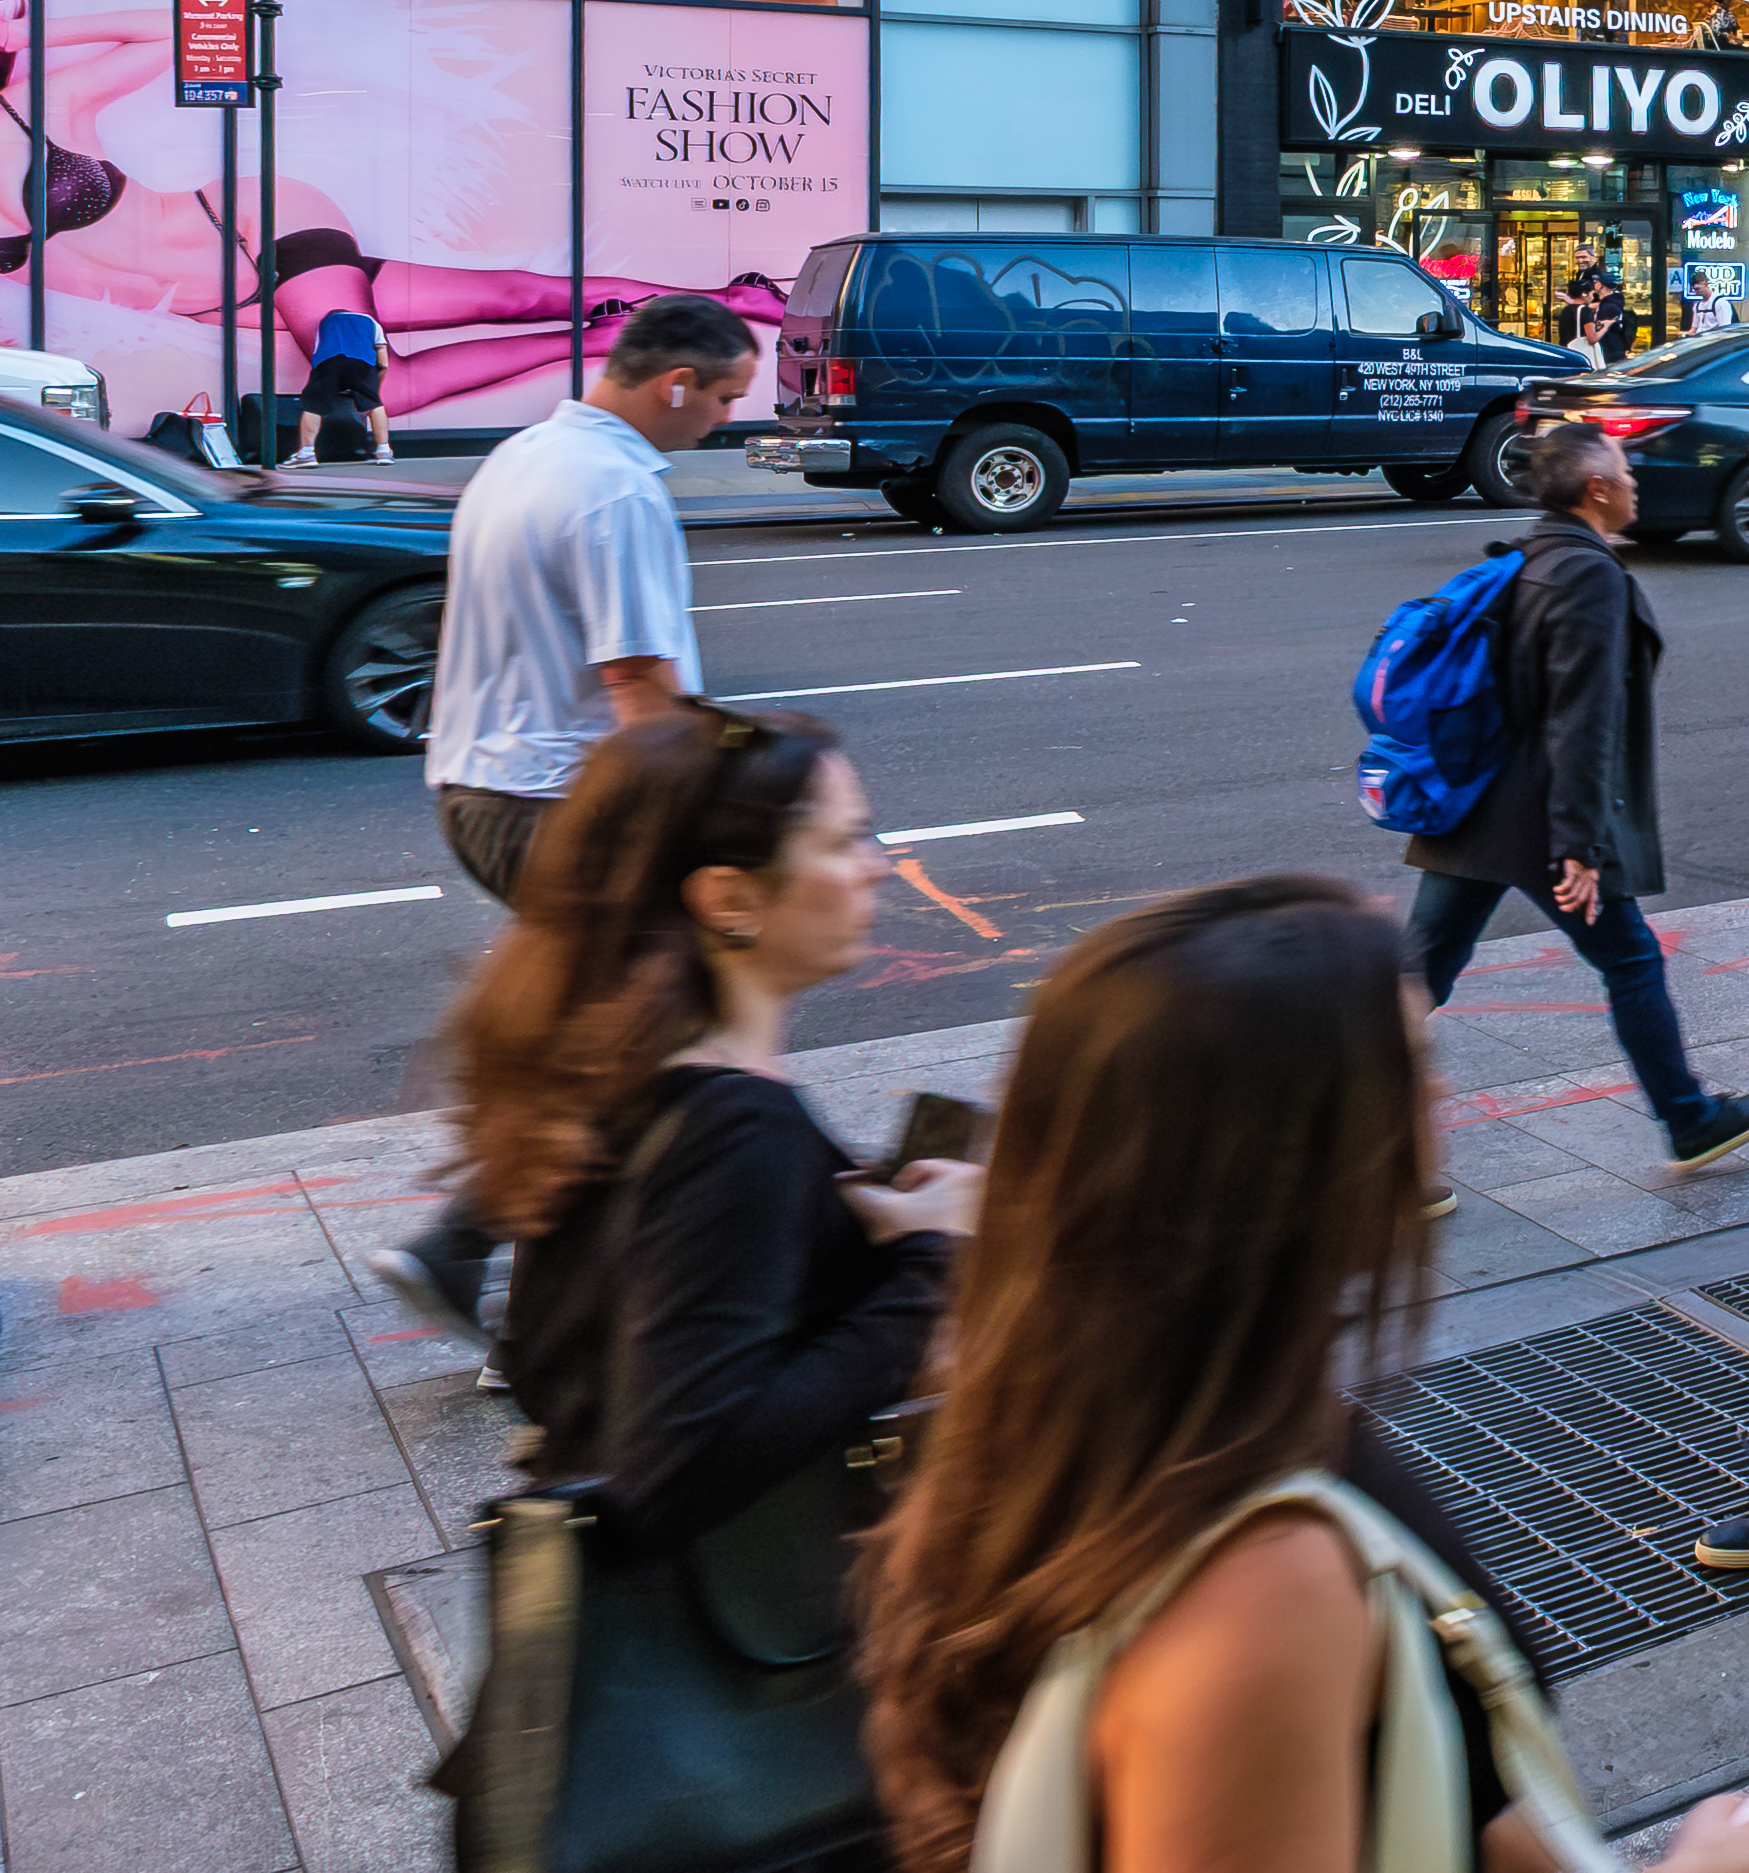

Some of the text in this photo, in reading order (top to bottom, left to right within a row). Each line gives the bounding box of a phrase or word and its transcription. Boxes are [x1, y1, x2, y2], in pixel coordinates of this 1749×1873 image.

[1488, 1, 1688, 35] UPSTAIRS DINING
[643, 64, 818, 85] VICTORIA'S SECRET
[625, 86, 833, 127] FASHION
[1395, 92, 1451, 117] DELI
[1472, 57, 1721, 136] OLIYO
[655, 128, 806, 164] SHOW
[712, 174, 813, 192] OCTOBER
[820, 177, 839, 192] 15
[1686, 229, 1736, 250] Modelo
[1402, 348, 1424, 361] B&L
[1358, 362, 1467, 377] 420 WEST 49TH STREET
[1363, 378, 1461, 392] NEW YORK, NY 10019
[1380, 394, 1443, 409] (212) 265-7771
